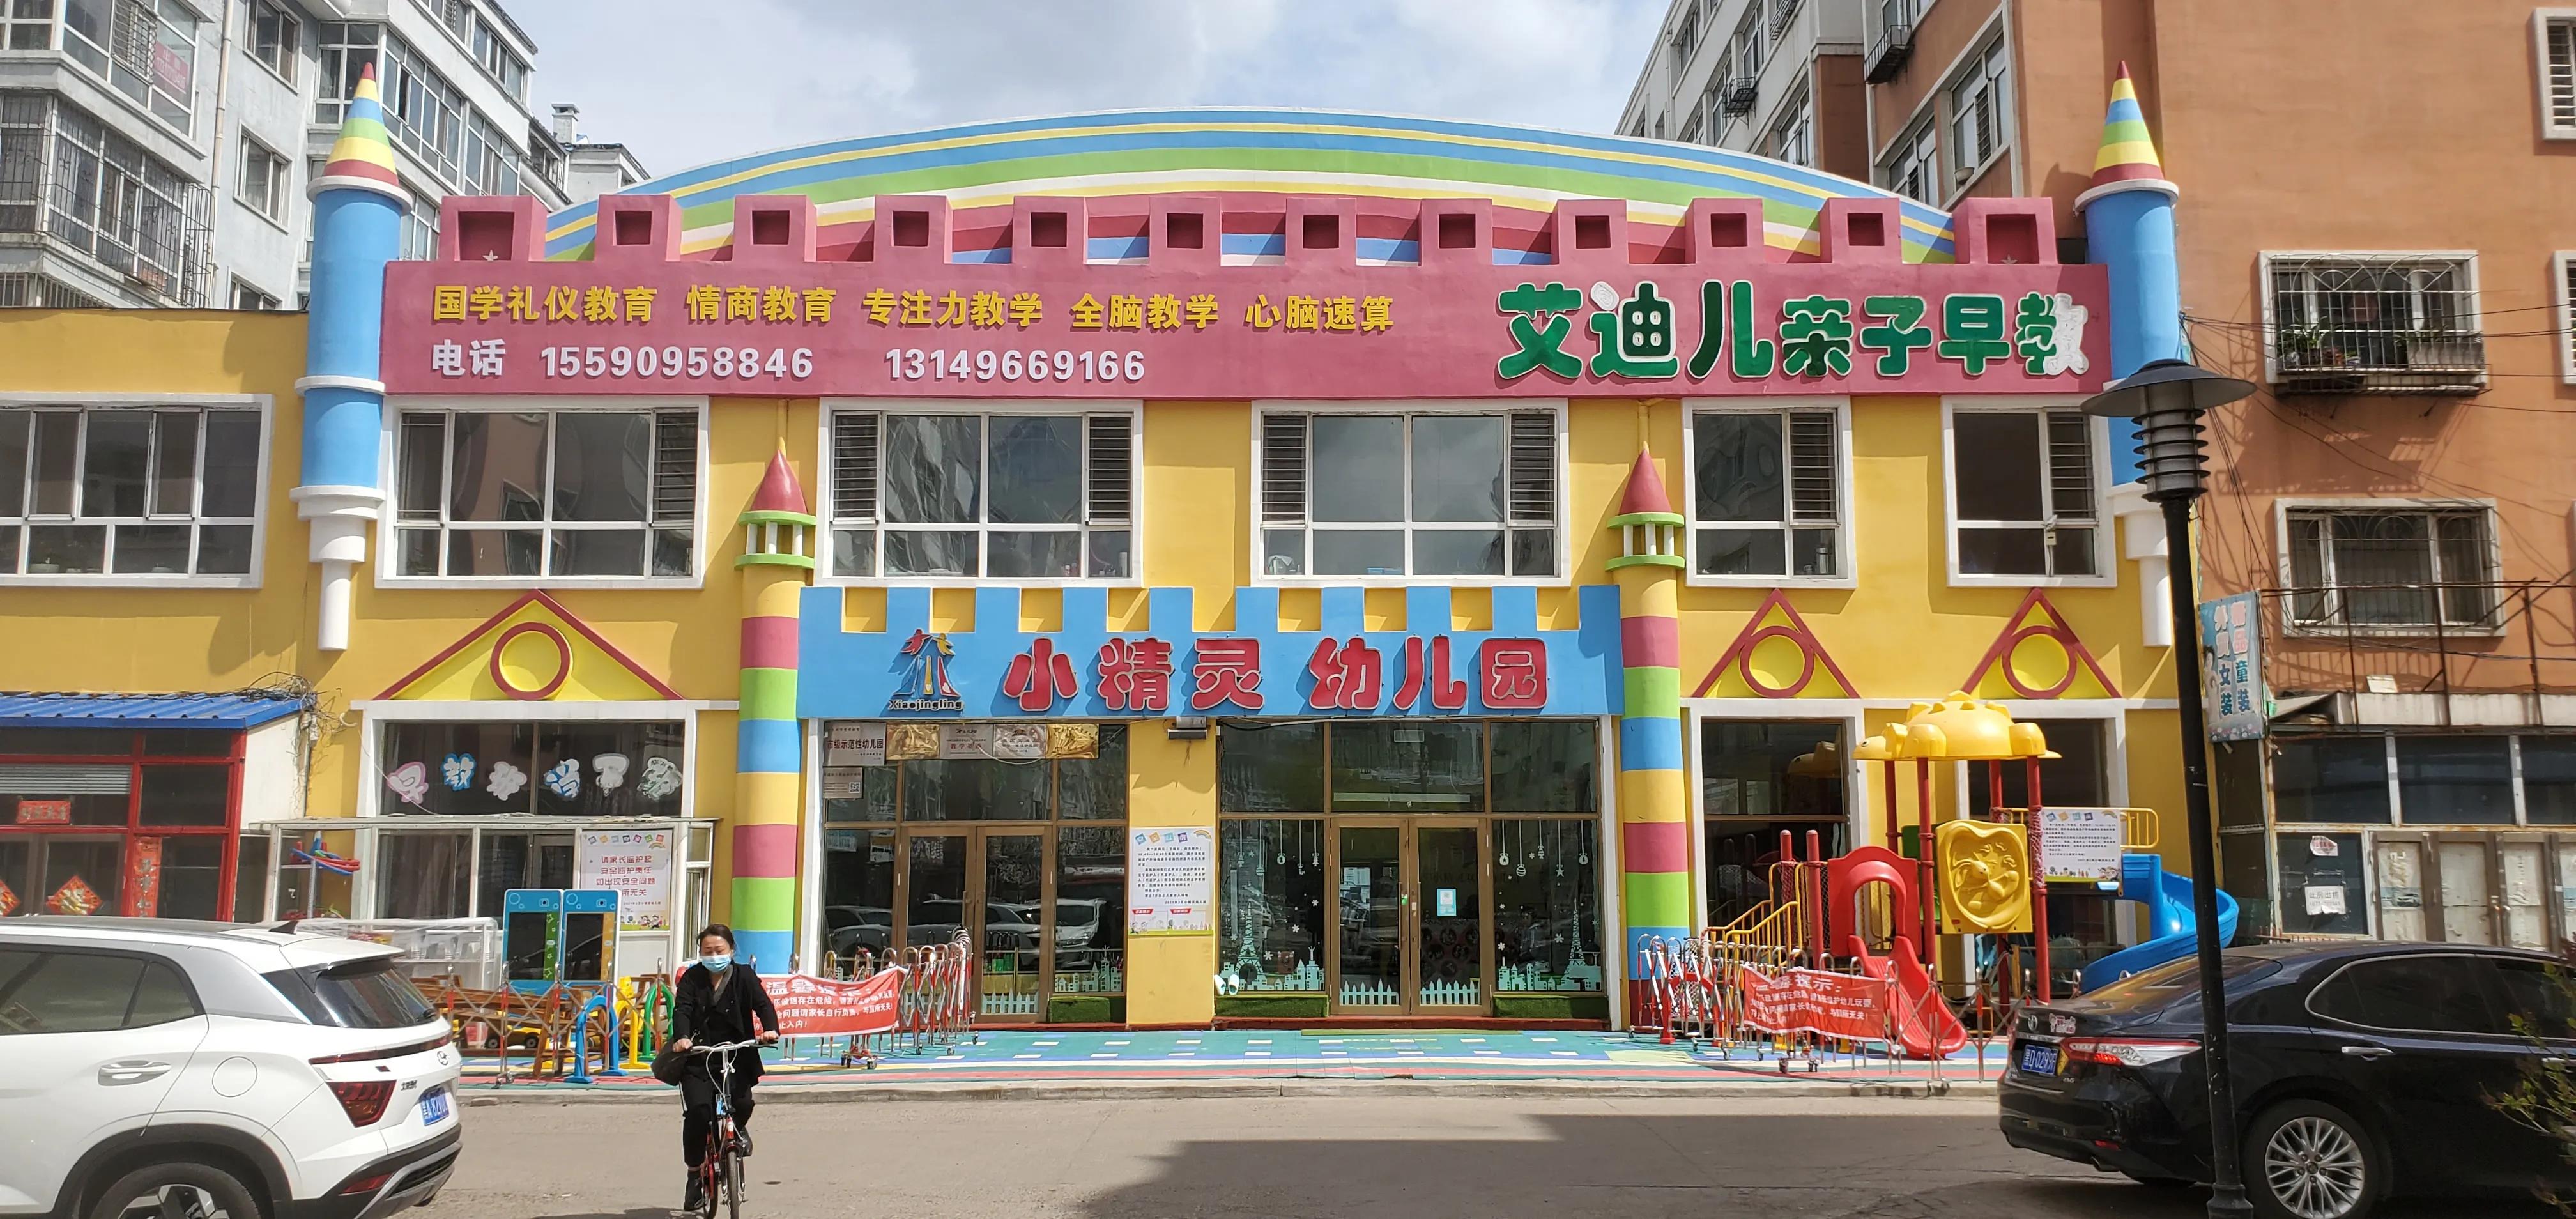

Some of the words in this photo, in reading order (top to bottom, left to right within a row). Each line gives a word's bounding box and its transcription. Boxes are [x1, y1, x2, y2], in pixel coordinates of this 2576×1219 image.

[434, 284, 657, 321] 国学礼仪教育
[687, 285, 836, 322] 情商教育
[863, 288, 1043, 326] 专注力教学
[1070, 293, 1219, 329] 全脑教学
[1245, 295, 1394, 332] 心脑速算
[431, 339, 505, 376] 电话
[540, 346, 813, 378] 15590958846
[884, 349, 1145, 381] 13149669166
[1003, 636, 1264, 712] 小精灵
[1309, 635, 1548, 710] 幼儿园
[889, 698, 963, 711] Xiaojingling
